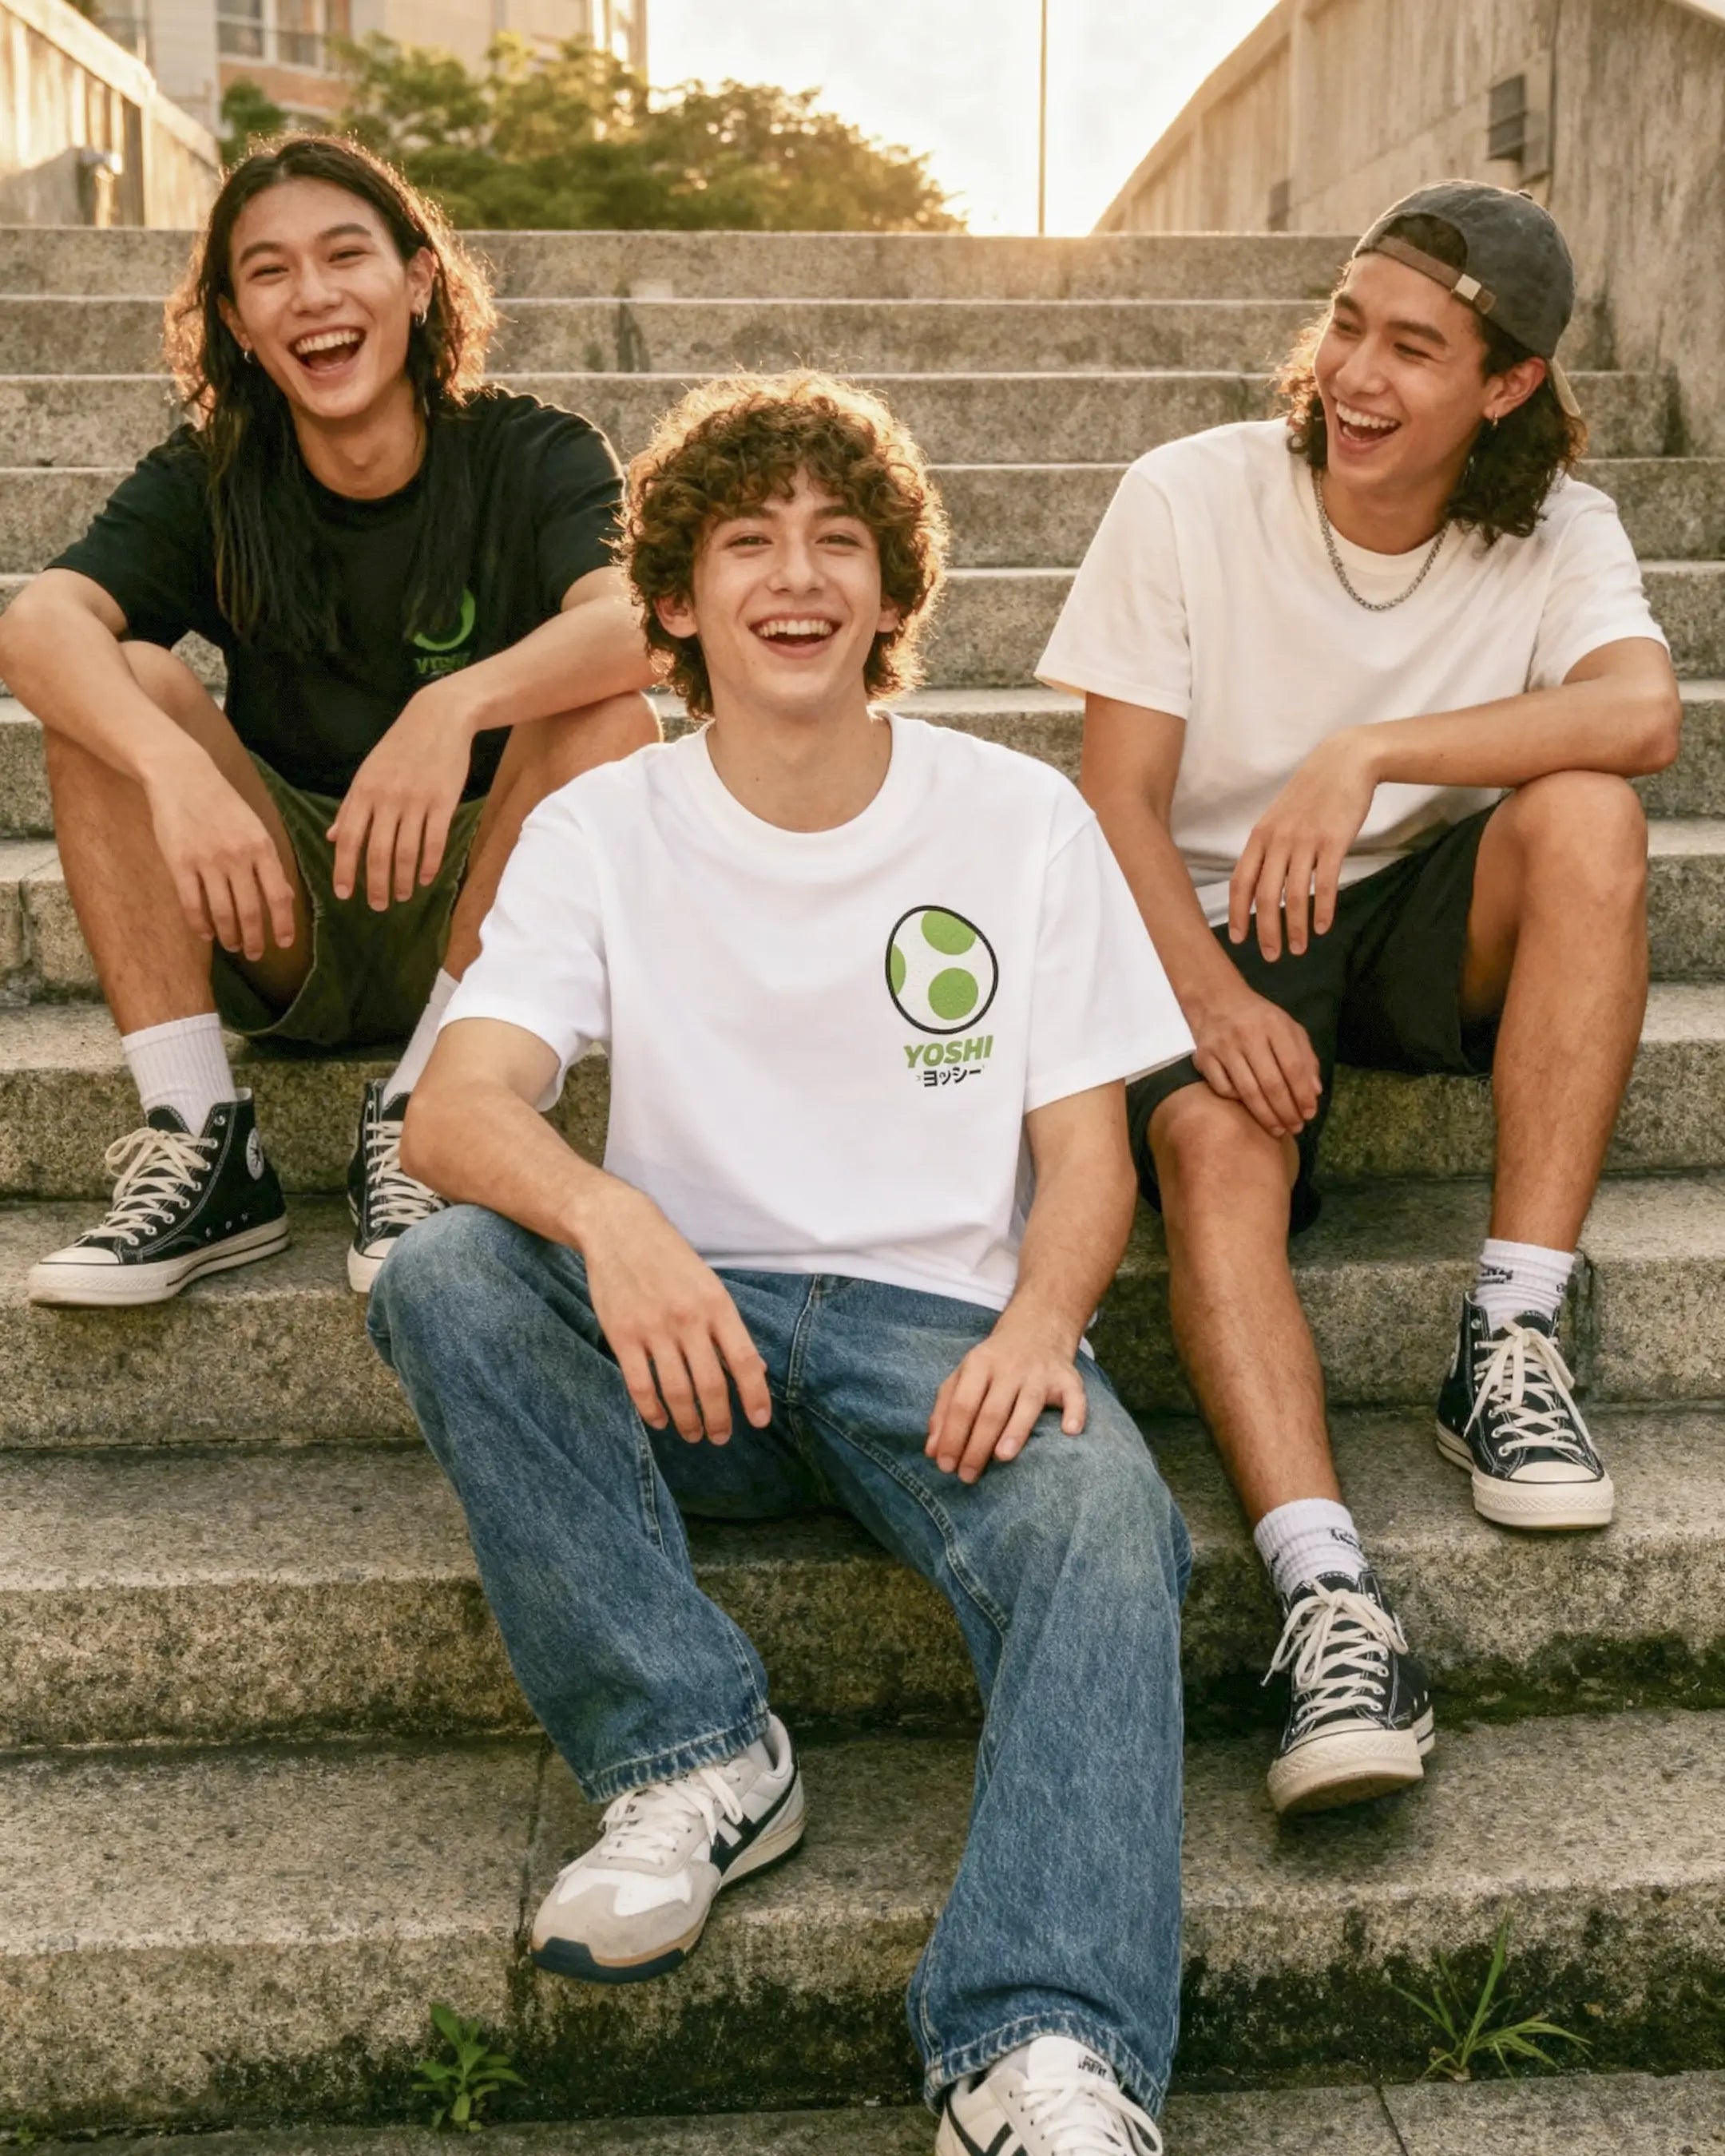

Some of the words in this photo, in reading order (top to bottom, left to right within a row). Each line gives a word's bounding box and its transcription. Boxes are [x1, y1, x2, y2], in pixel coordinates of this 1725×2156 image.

[903, 1036, 993, 1068] YOSHI
[923, 1066, 981, 1088] ヨッシー
